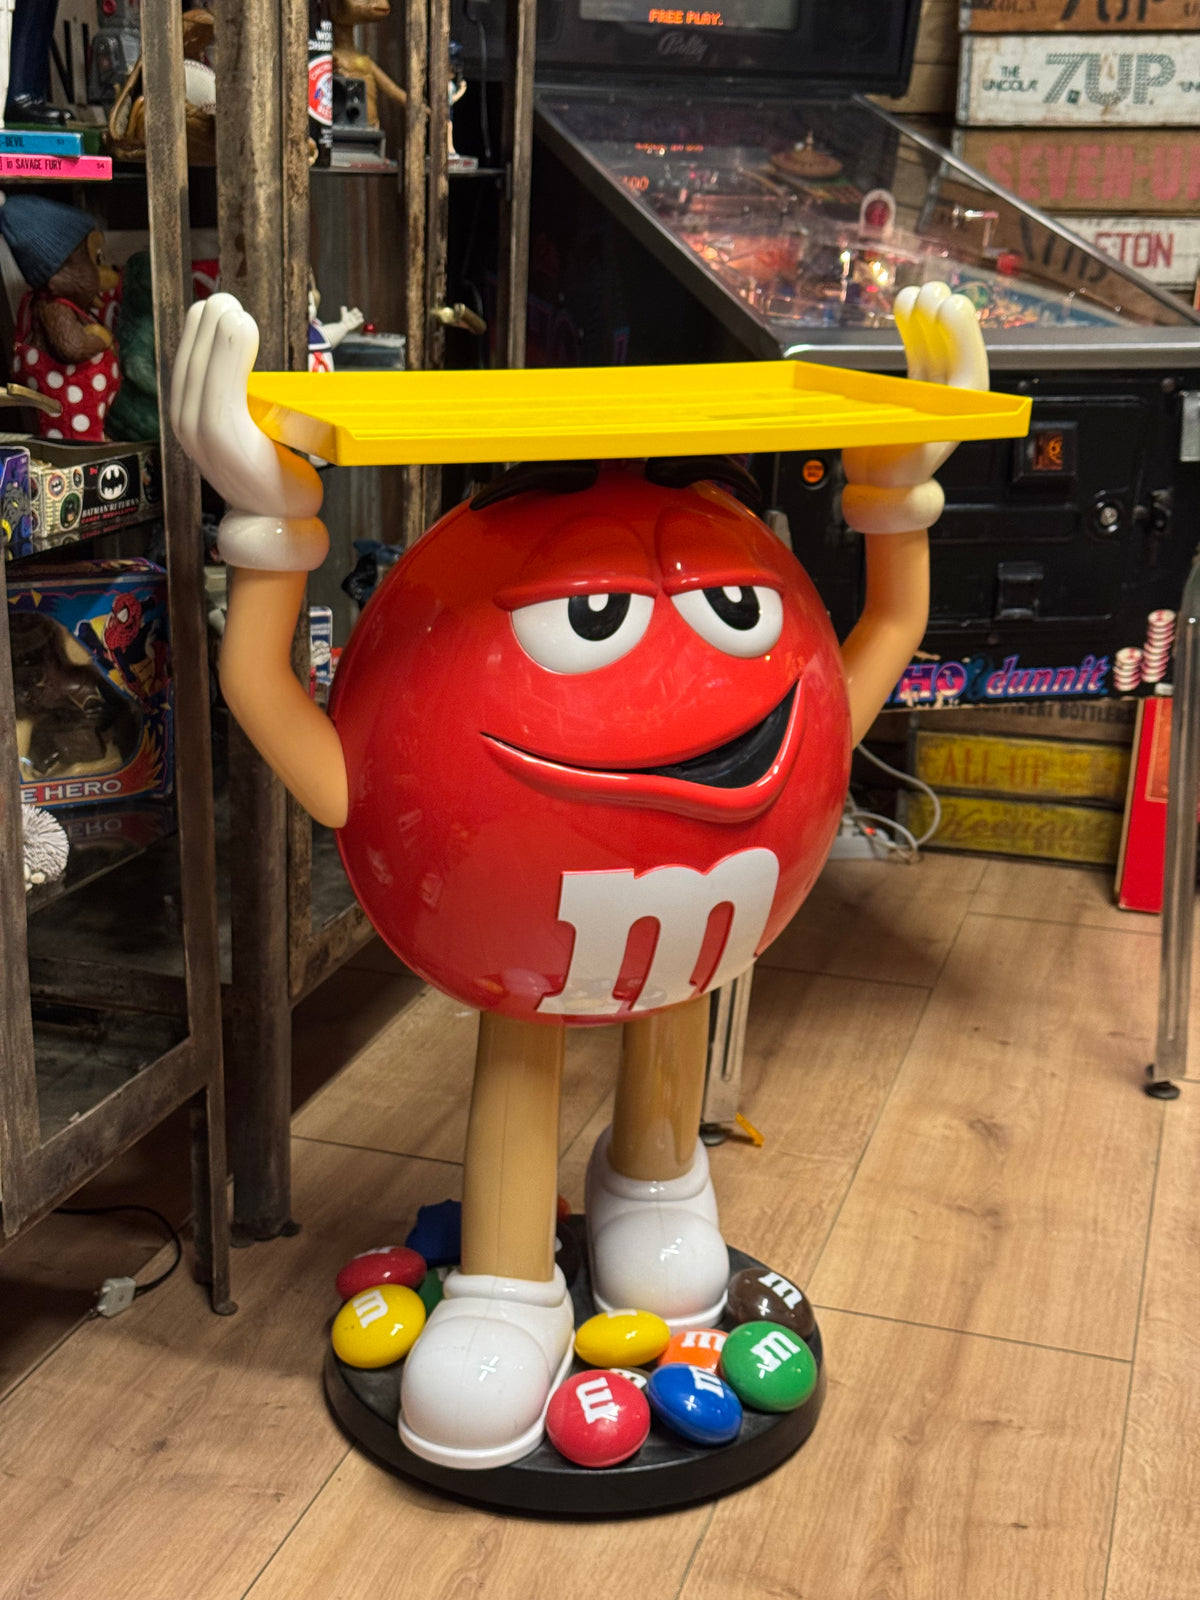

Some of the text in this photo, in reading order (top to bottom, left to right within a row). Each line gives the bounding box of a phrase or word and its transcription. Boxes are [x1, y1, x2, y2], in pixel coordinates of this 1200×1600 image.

[649, 8, 684, 24] FREE
[16, 158, 42, 170] SAVAGE
[45, 158, 62, 171] FURY
[82, 504, 108, 518] BATMAN
[986, 654, 1110, 698] dunnit
[44, 779, 122, 800] HERO
